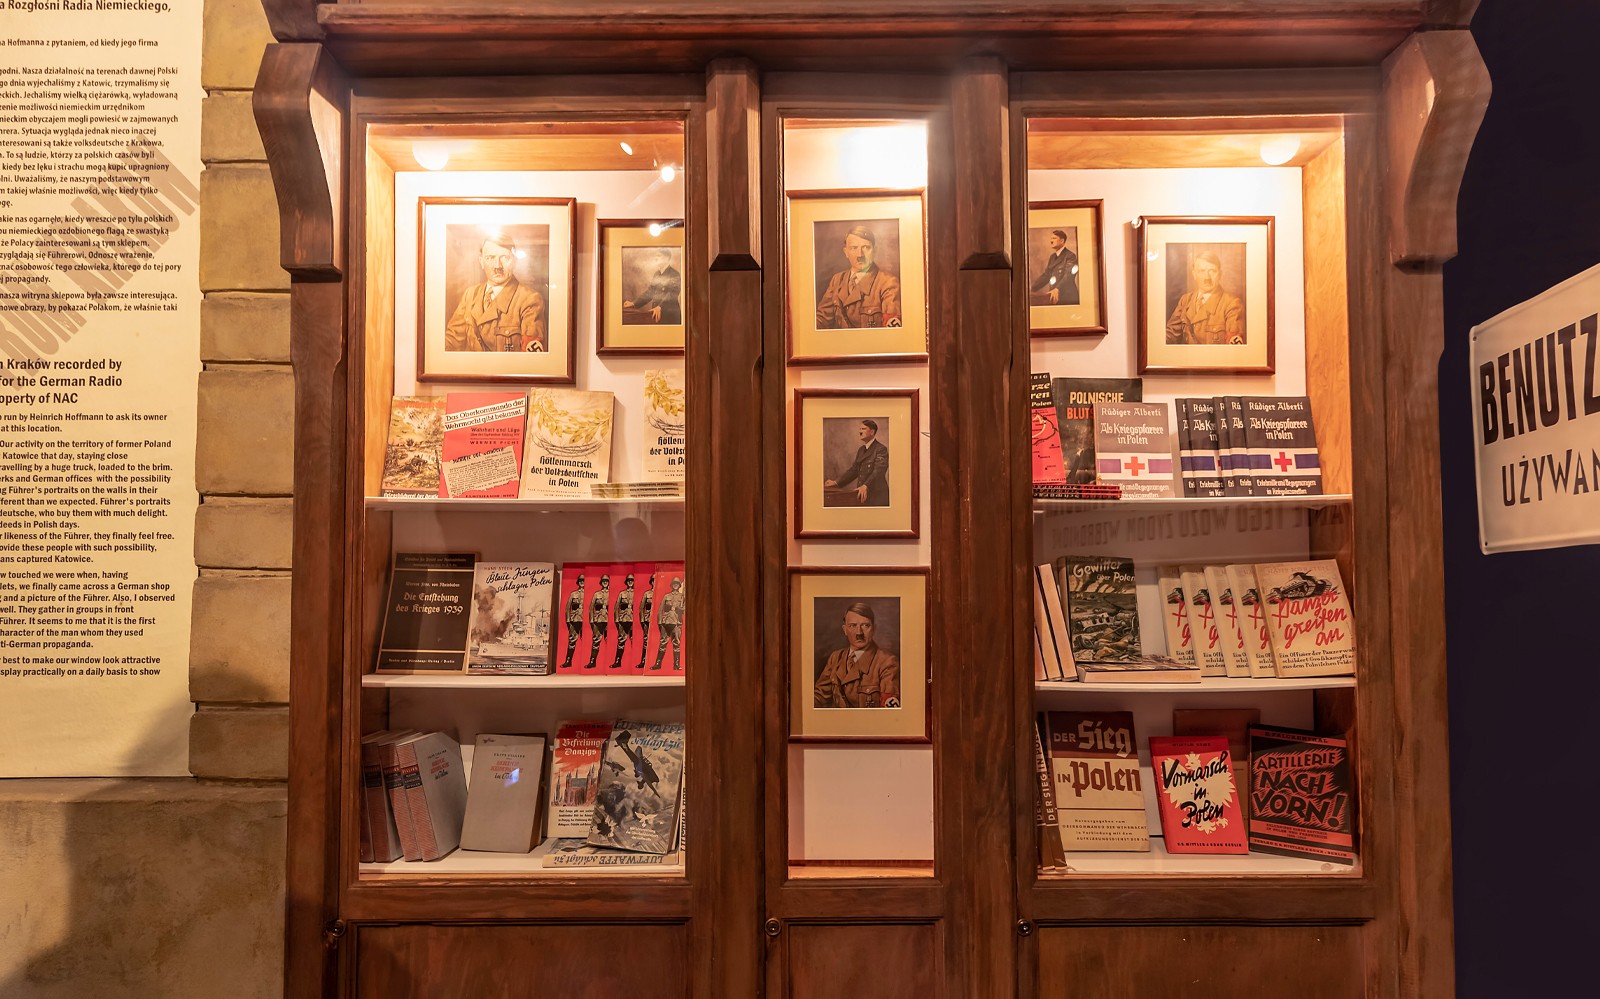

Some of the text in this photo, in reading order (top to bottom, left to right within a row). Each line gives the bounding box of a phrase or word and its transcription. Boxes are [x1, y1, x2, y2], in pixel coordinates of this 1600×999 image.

[62, 0, 93, 10] Radia
[7, 38, 45, 46] Hofmanna
[89, 38, 99, 47] od
[100, 38, 120, 48] kiedy
[120, 38, 136, 48] jego
[138, 38, 159, 47] firma
[54, 358, 106, 370] recorded
[109, 358, 122, 372] by
[16, 376, 36, 387] the
[39, 375, 86, 387] German
[88, 375, 122, 387] Radio
[1480, 312, 1600, 446] BENUTZ
[38, 392, 78, 404] of NAC
[1070, 392, 1124, 404] POLNISCHE
[1134, 407, 1162, 417] Alberti
[1278, 402, 1304, 410] Alberti
[18, 413, 28, 422] by
[29, 413, 64, 421] Heinrich
[64, 413, 104, 421] Hoffmann
[105, 413, 114, 421] to
[116, 413, 130, 421] ask
[131, 413, 142, 421] its
[1250, 418, 1261, 429] Als
[1100, 422, 1113, 434] Als
[1117, 434, 1148, 445] in Polen
[1266, 430, 1294, 439] in Polen
[15, 440, 44, 449] activity
[56, 440, 70, 448] the
[72, 440, 104, 449] territory
[106, 440, 114, 448] of
[115, 440, 143, 448] former
[143, 440, 172, 448] Poland
[658, 436, 685, 446] Höllen
[663, 447, 685, 456] Volks
[548, 478, 556, 486] in
[4, 532, 38, 540] likeness
[38, 532, 48, 540] of
[48, 532, 62, 540] the
[94, 532, 111, 541] they
[112, 532, 137, 541] finally
[138, 532, 154, 540] feel
[1073, 560, 1122, 578] Gewitter
[444, 604, 464, 615] 1939
[1053, 732, 1076, 742] DER
[1078, 720, 1131, 758] Sieg
[1257, 752, 1336, 770] ARTILLERIE
[1162, 751, 1228, 789] Vormarsch
[1057, 761, 1142, 797] IN Polen
[1259, 770, 1326, 794] NACH
[1193, 783, 1207, 800] in
[1180, 800, 1224, 828] Polen
[1252, 792, 1346, 827] VORN!
